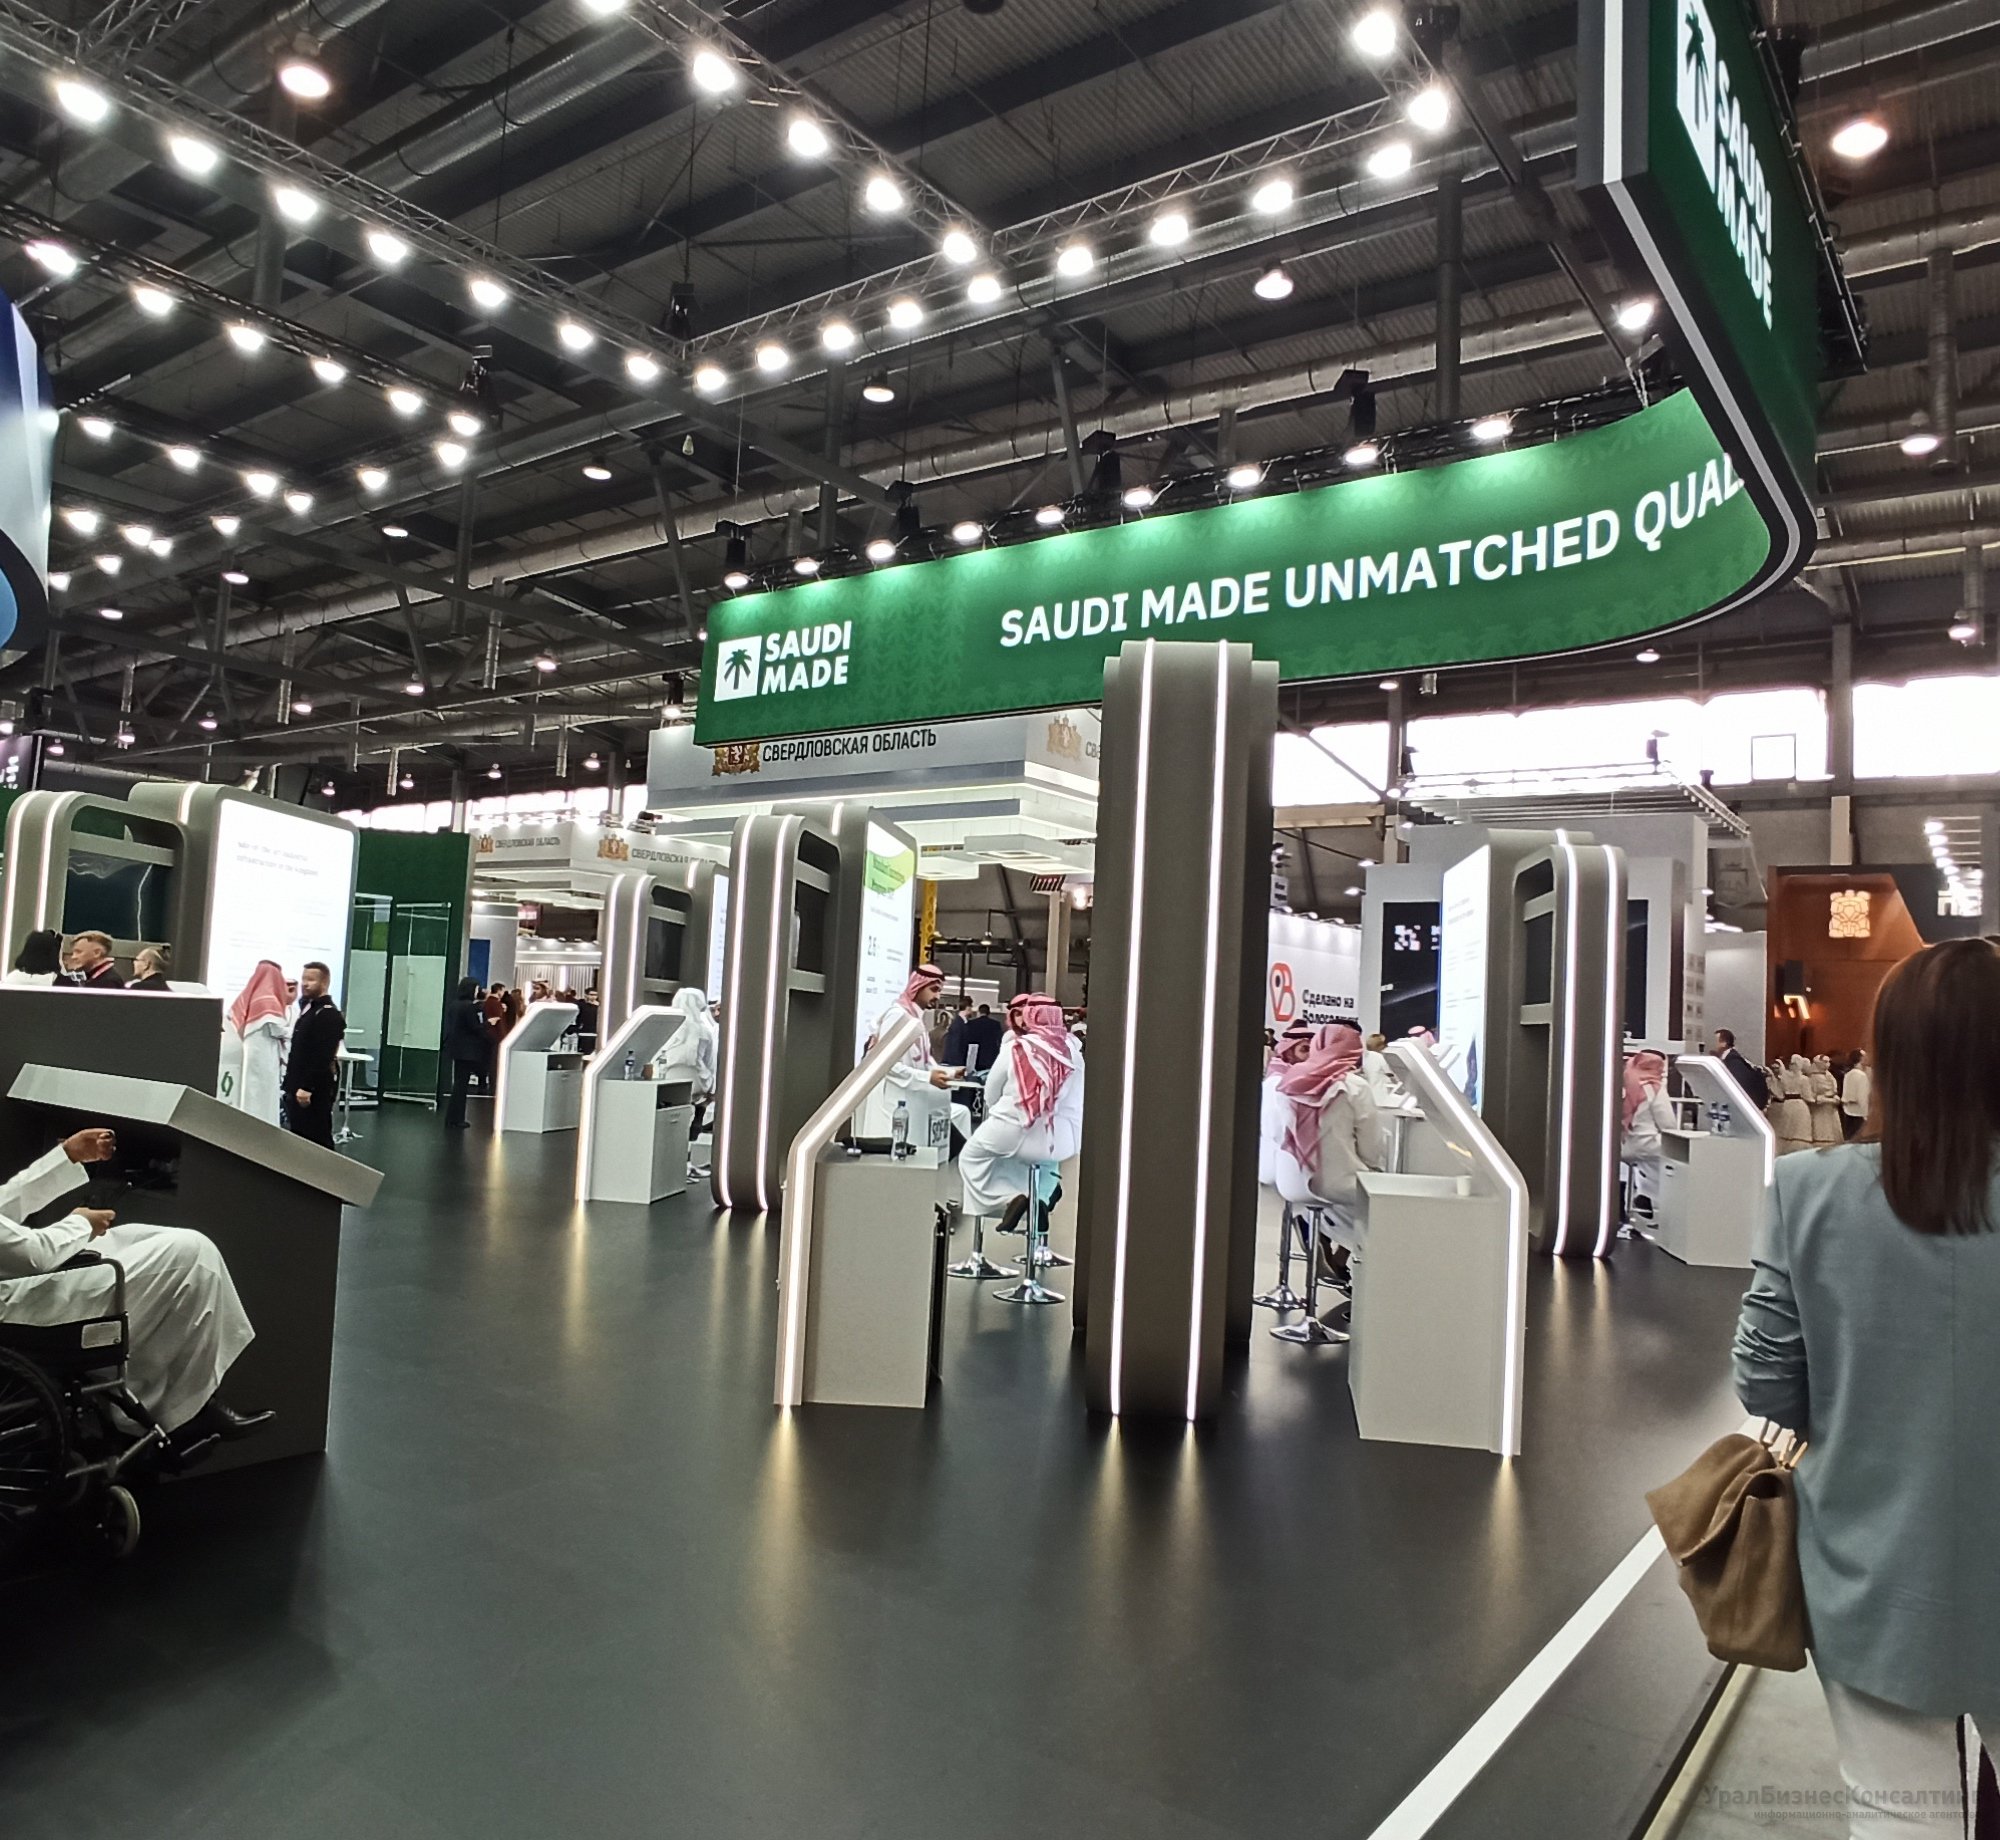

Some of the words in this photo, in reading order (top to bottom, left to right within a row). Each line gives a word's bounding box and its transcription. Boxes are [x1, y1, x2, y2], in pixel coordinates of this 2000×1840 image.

[1717, 59, 1772, 255] SAUDI
[1717, 142, 1772, 331] MADE
[999, 592, 1129, 648] SAUDI
[1141, 570, 1271, 628] MADE
[1284, 509, 1620, 609] UNMATCHED
[763, 620, 853, 663] SAUDI
[761, 656, 849, 696] MADE
[762, 735, 869, 762] СВЕРДЛОВСКАЯ
[872, 728, 937, 753] ОБЛАСТЬ
[1302, 989, 1341, 1008] Сделано
[1343, 997, 1355, 1009] на
